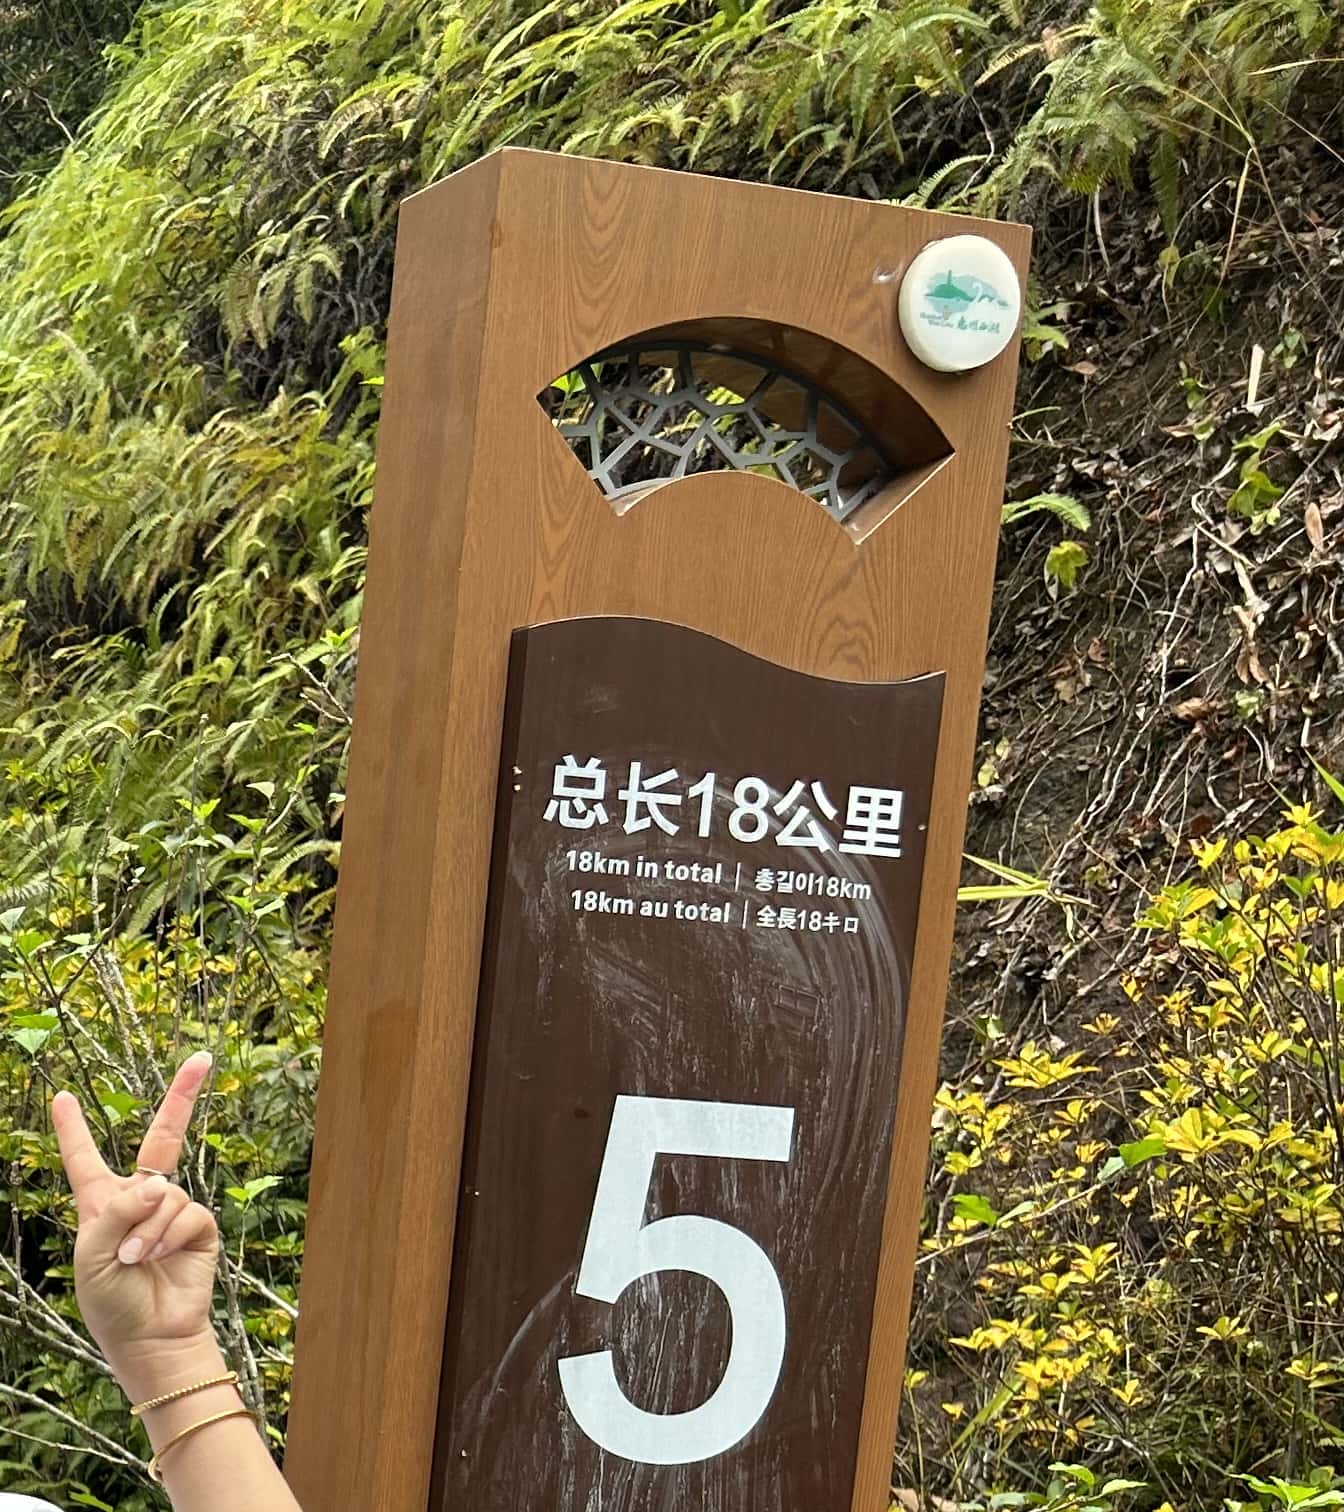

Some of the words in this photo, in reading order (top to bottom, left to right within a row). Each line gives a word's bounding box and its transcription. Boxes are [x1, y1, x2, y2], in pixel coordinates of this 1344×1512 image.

[543, 755, 904, 858] 总长18公里
[566, 850, 630, 876] 18km
[636, 856, 658, 878] in
[664, 860, 721, 884] total
[755, 868, 871, 900] 총길이18km
[571, 889, 634, 915] 18km
[640, 900, 668, 918] au
[674, 900, 731, 923] total
[756, 904, 859, 933] 全長18キロ
[558, 1094, 795, 1465] 5
